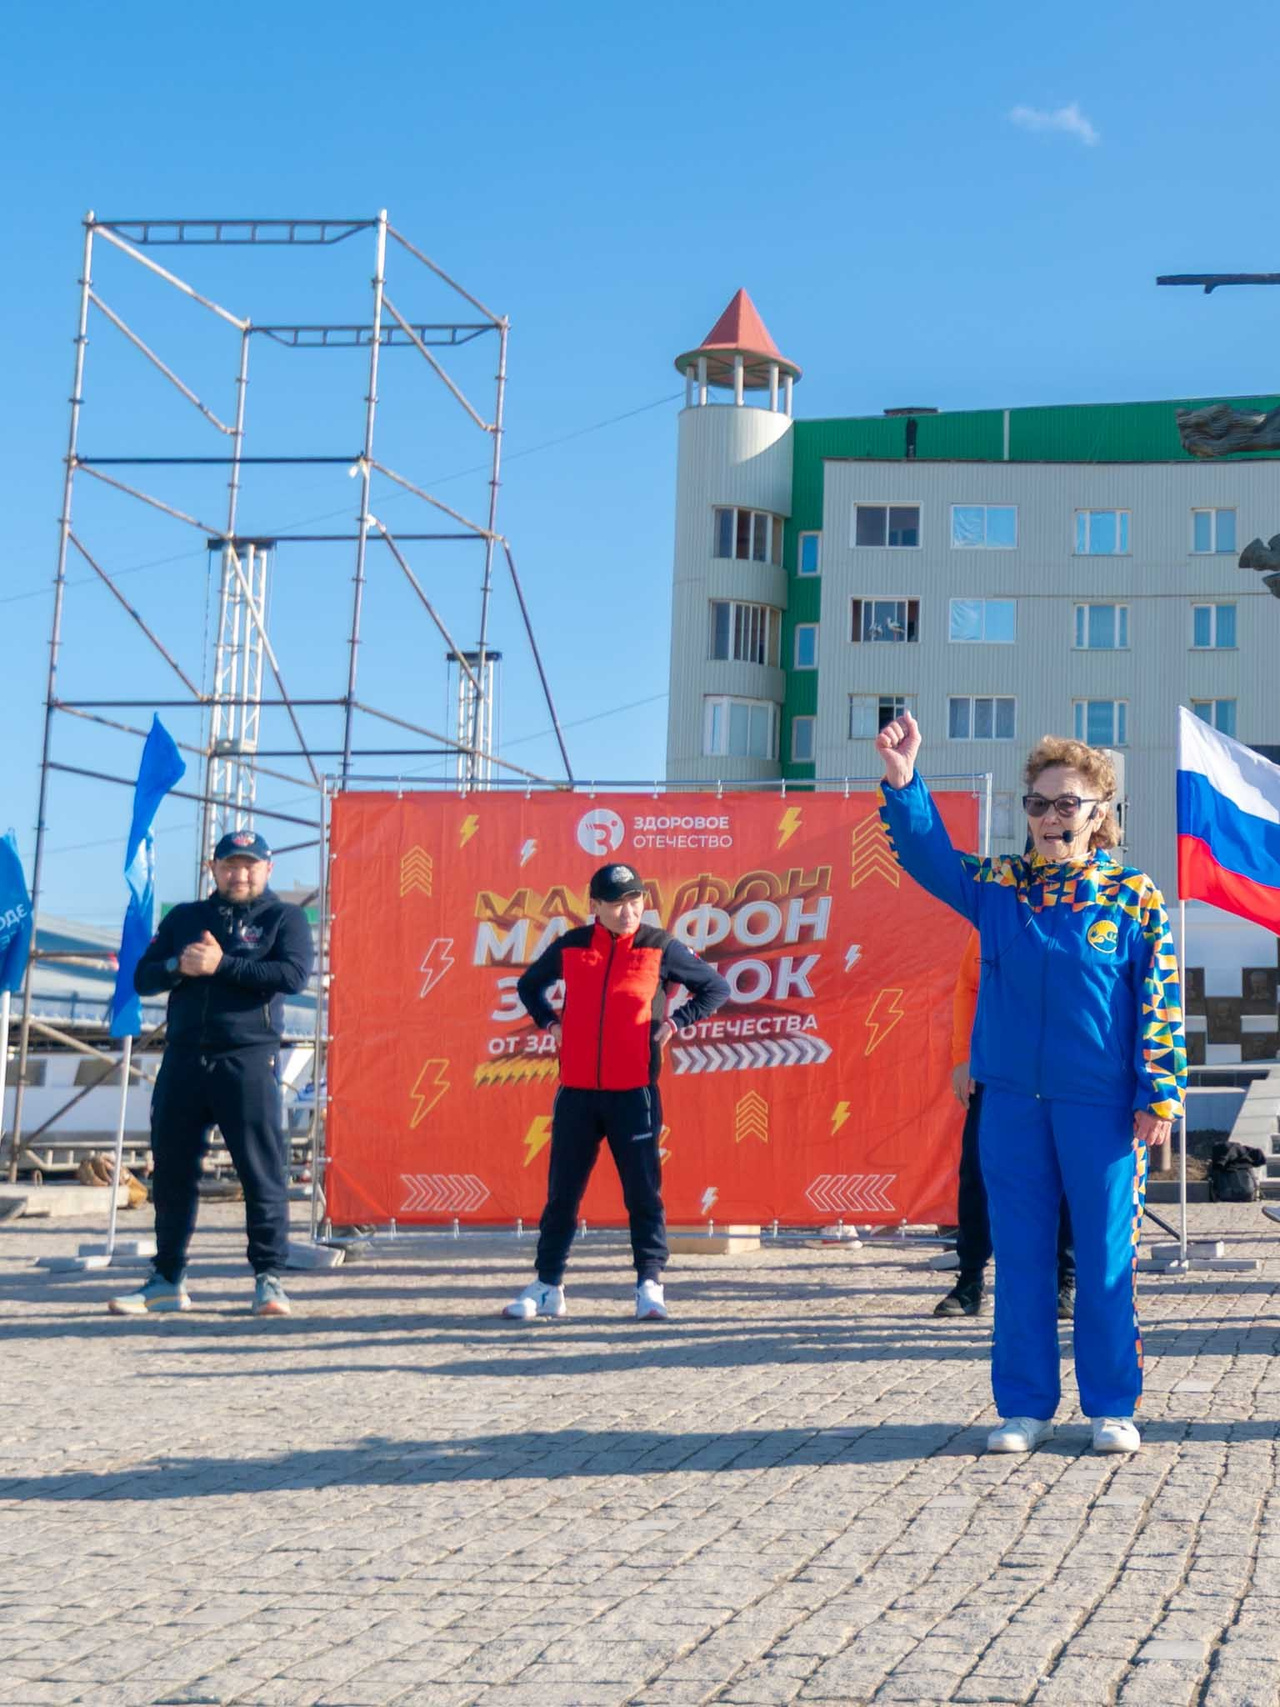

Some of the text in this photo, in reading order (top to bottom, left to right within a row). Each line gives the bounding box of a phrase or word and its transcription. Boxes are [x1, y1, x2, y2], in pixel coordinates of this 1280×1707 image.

[633, 816, 729, 831] ЗДОРОВОЕ
[633, 835, 733, 848] ОТЕЧЕСТВО
[488, 1035, 520, 1055] ОТ
[679, 1014, 818, 1041] ОТЕЧЕСТВА
